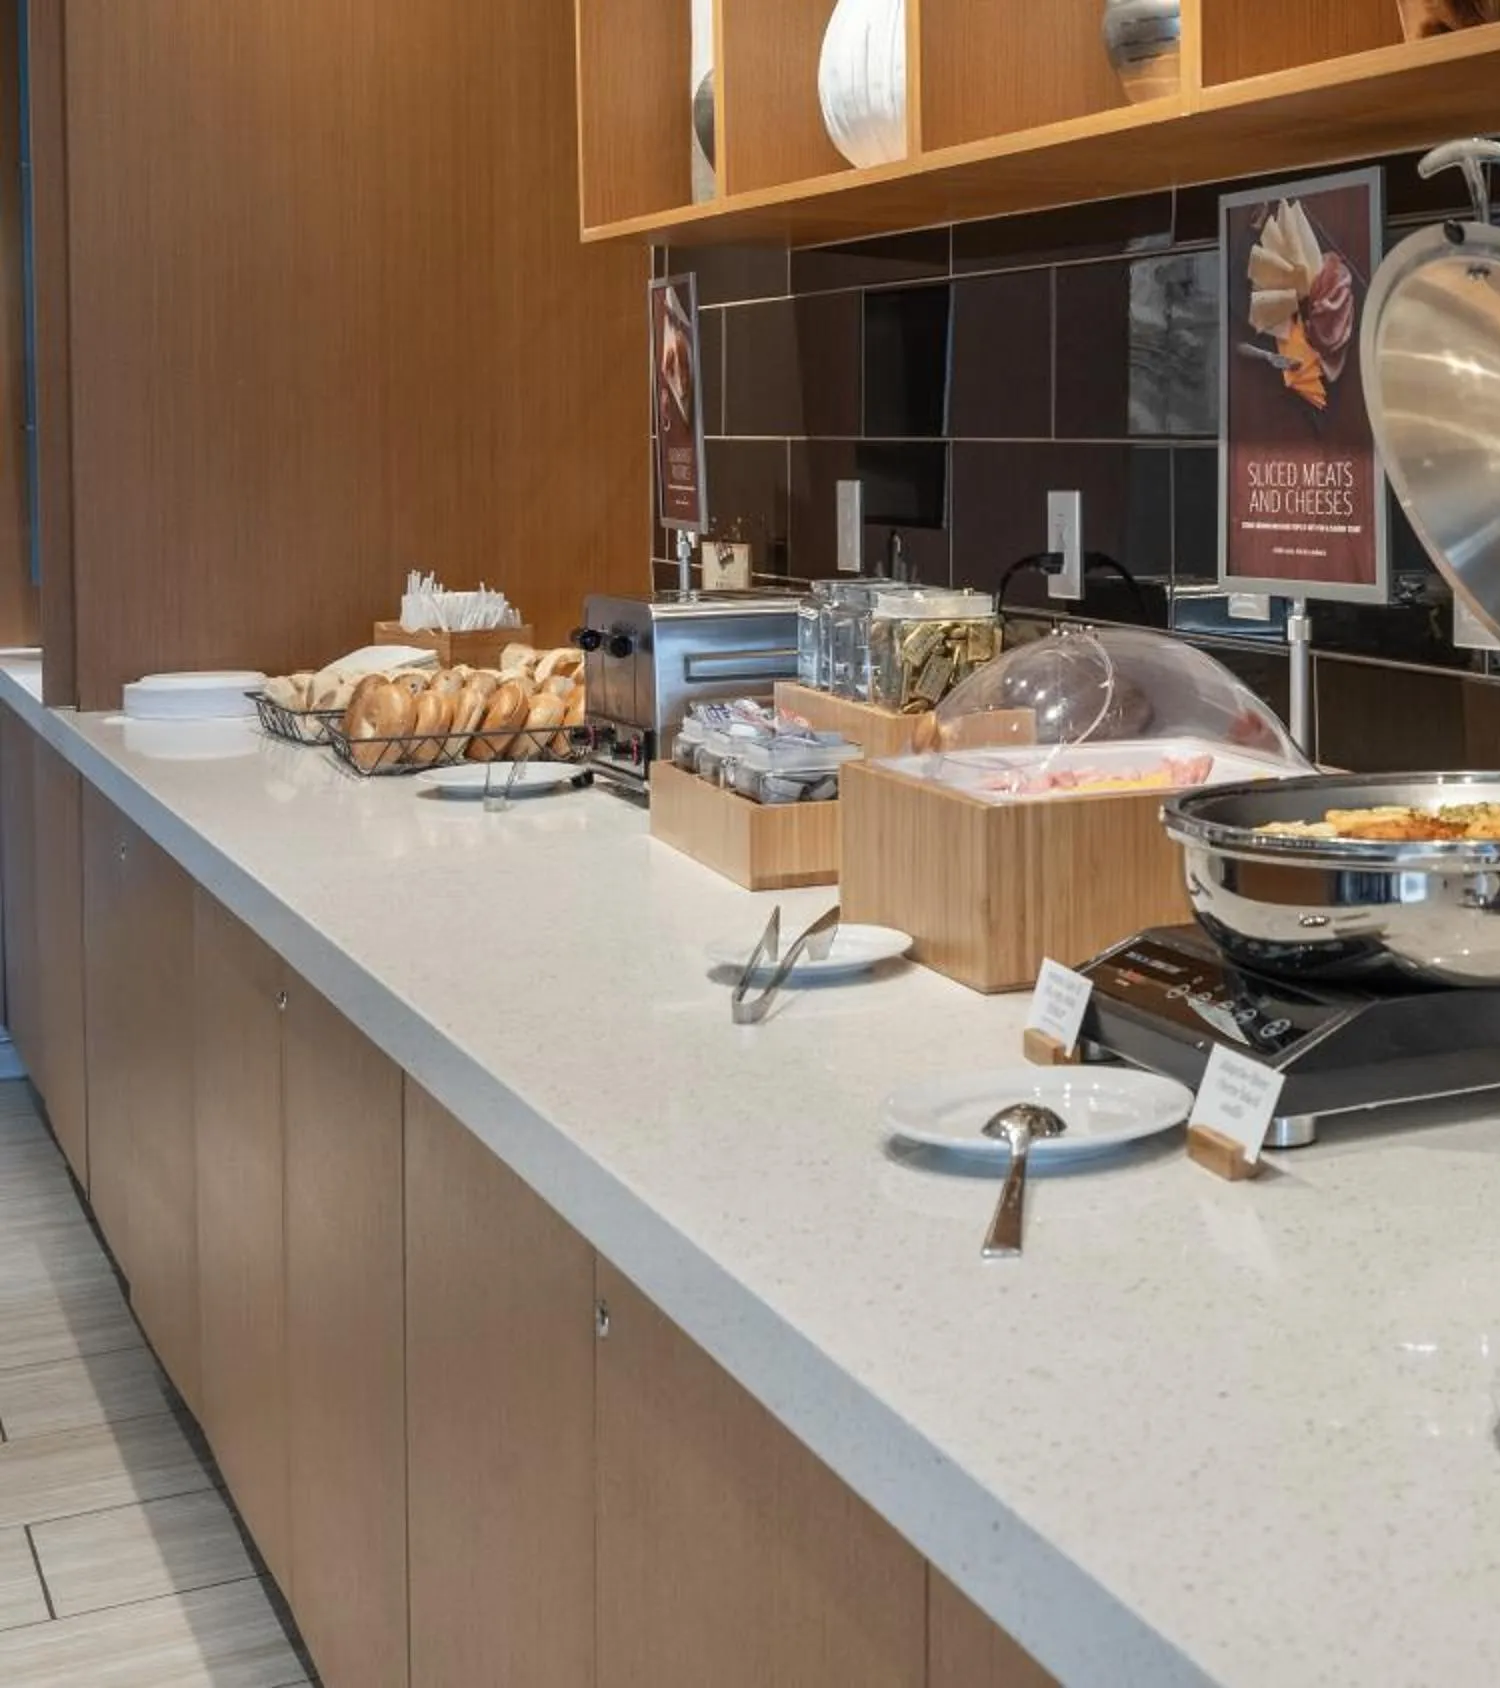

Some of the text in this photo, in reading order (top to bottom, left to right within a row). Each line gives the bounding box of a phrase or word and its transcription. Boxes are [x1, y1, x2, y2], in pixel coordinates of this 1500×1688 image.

[1247, 462, 1353, 488] SLICED MEATS
[1249, 489, 1353, 516] AND CHEESES
